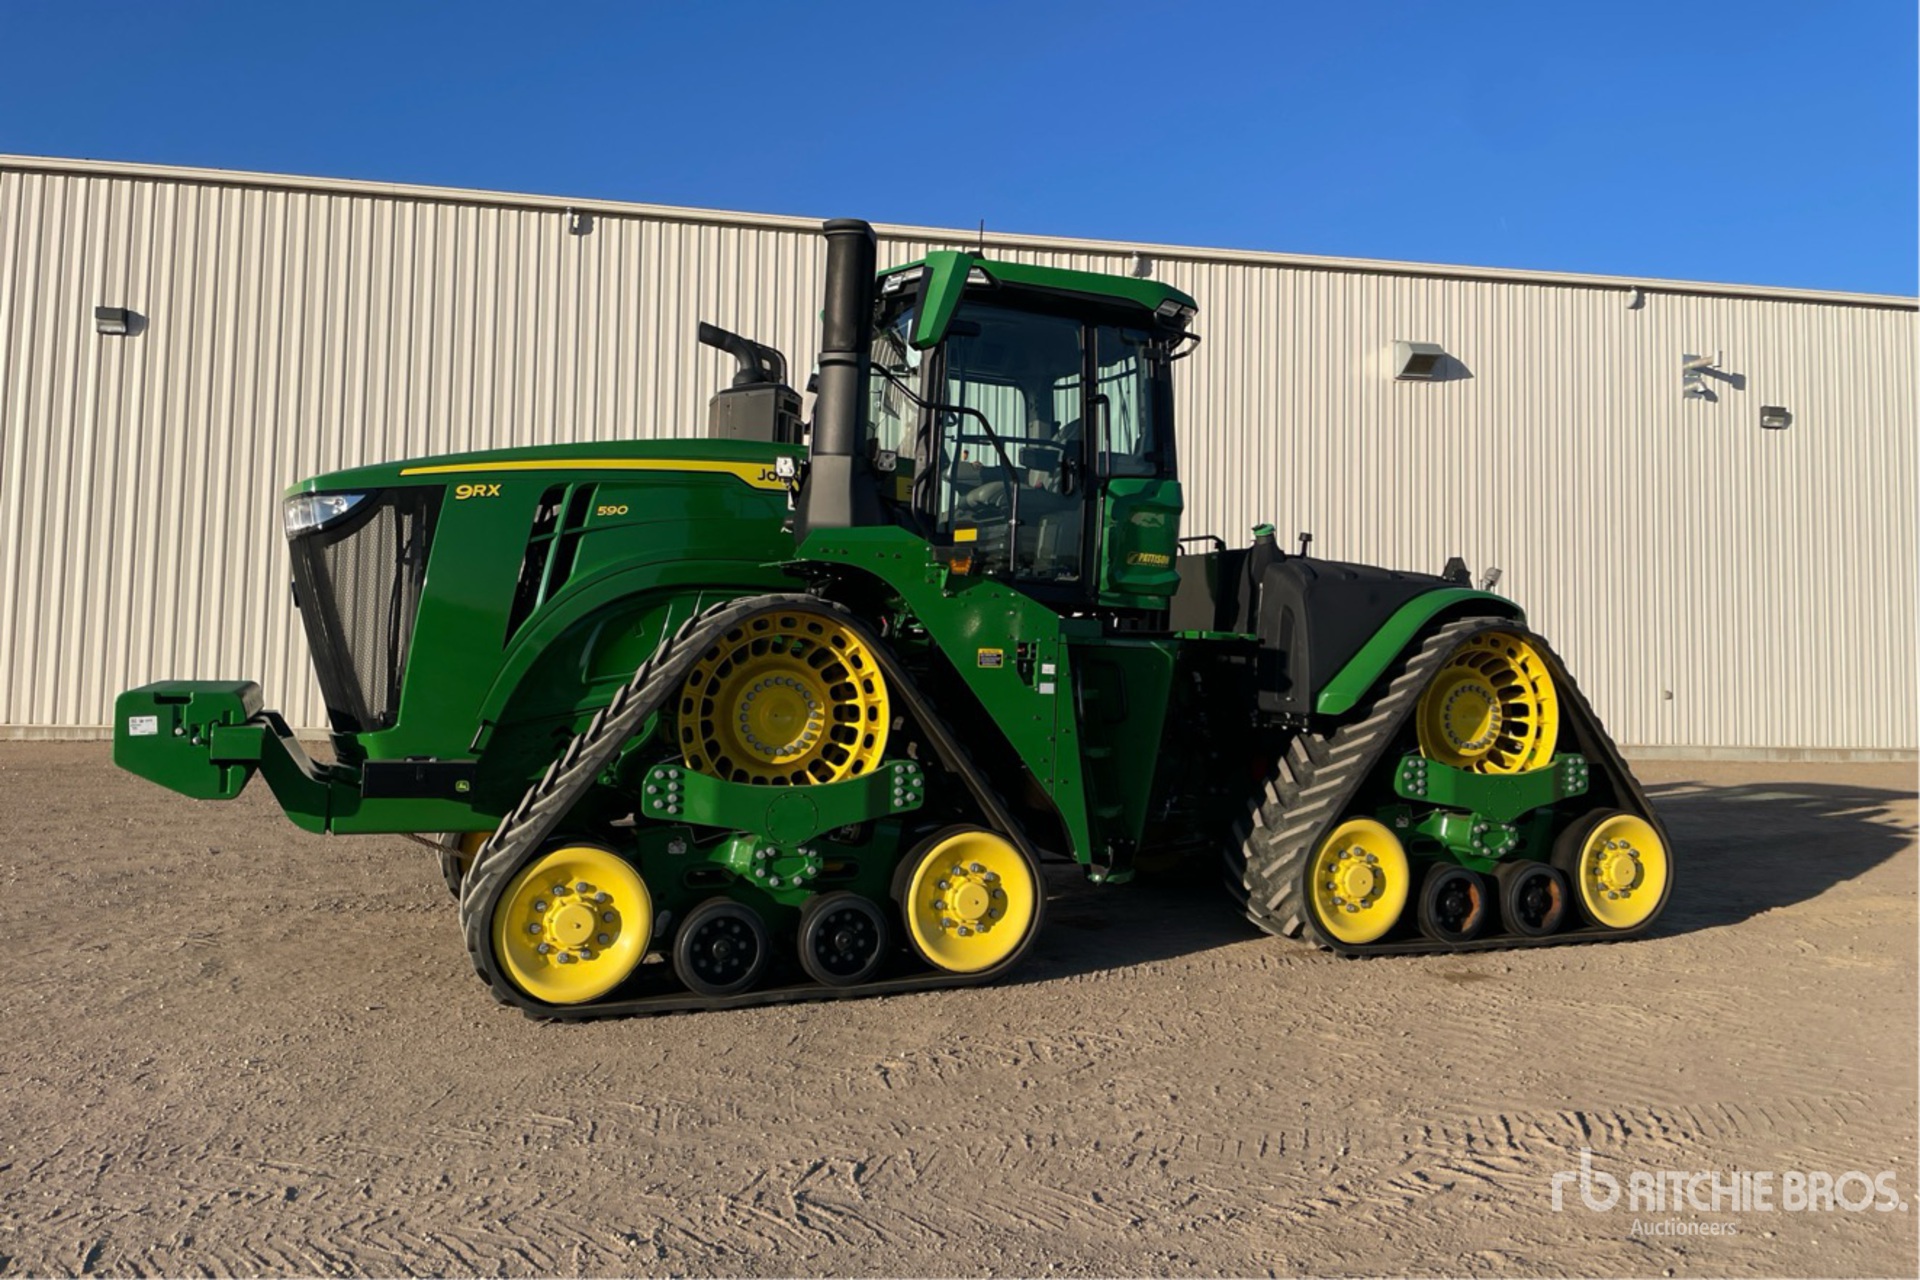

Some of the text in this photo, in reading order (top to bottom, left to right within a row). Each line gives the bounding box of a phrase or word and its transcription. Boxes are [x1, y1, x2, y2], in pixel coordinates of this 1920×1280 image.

[455, 484, 501, 500] 9RX
[597, 505, 628, 516] 590
[1139, 552, 1169, 564] PATTISON
